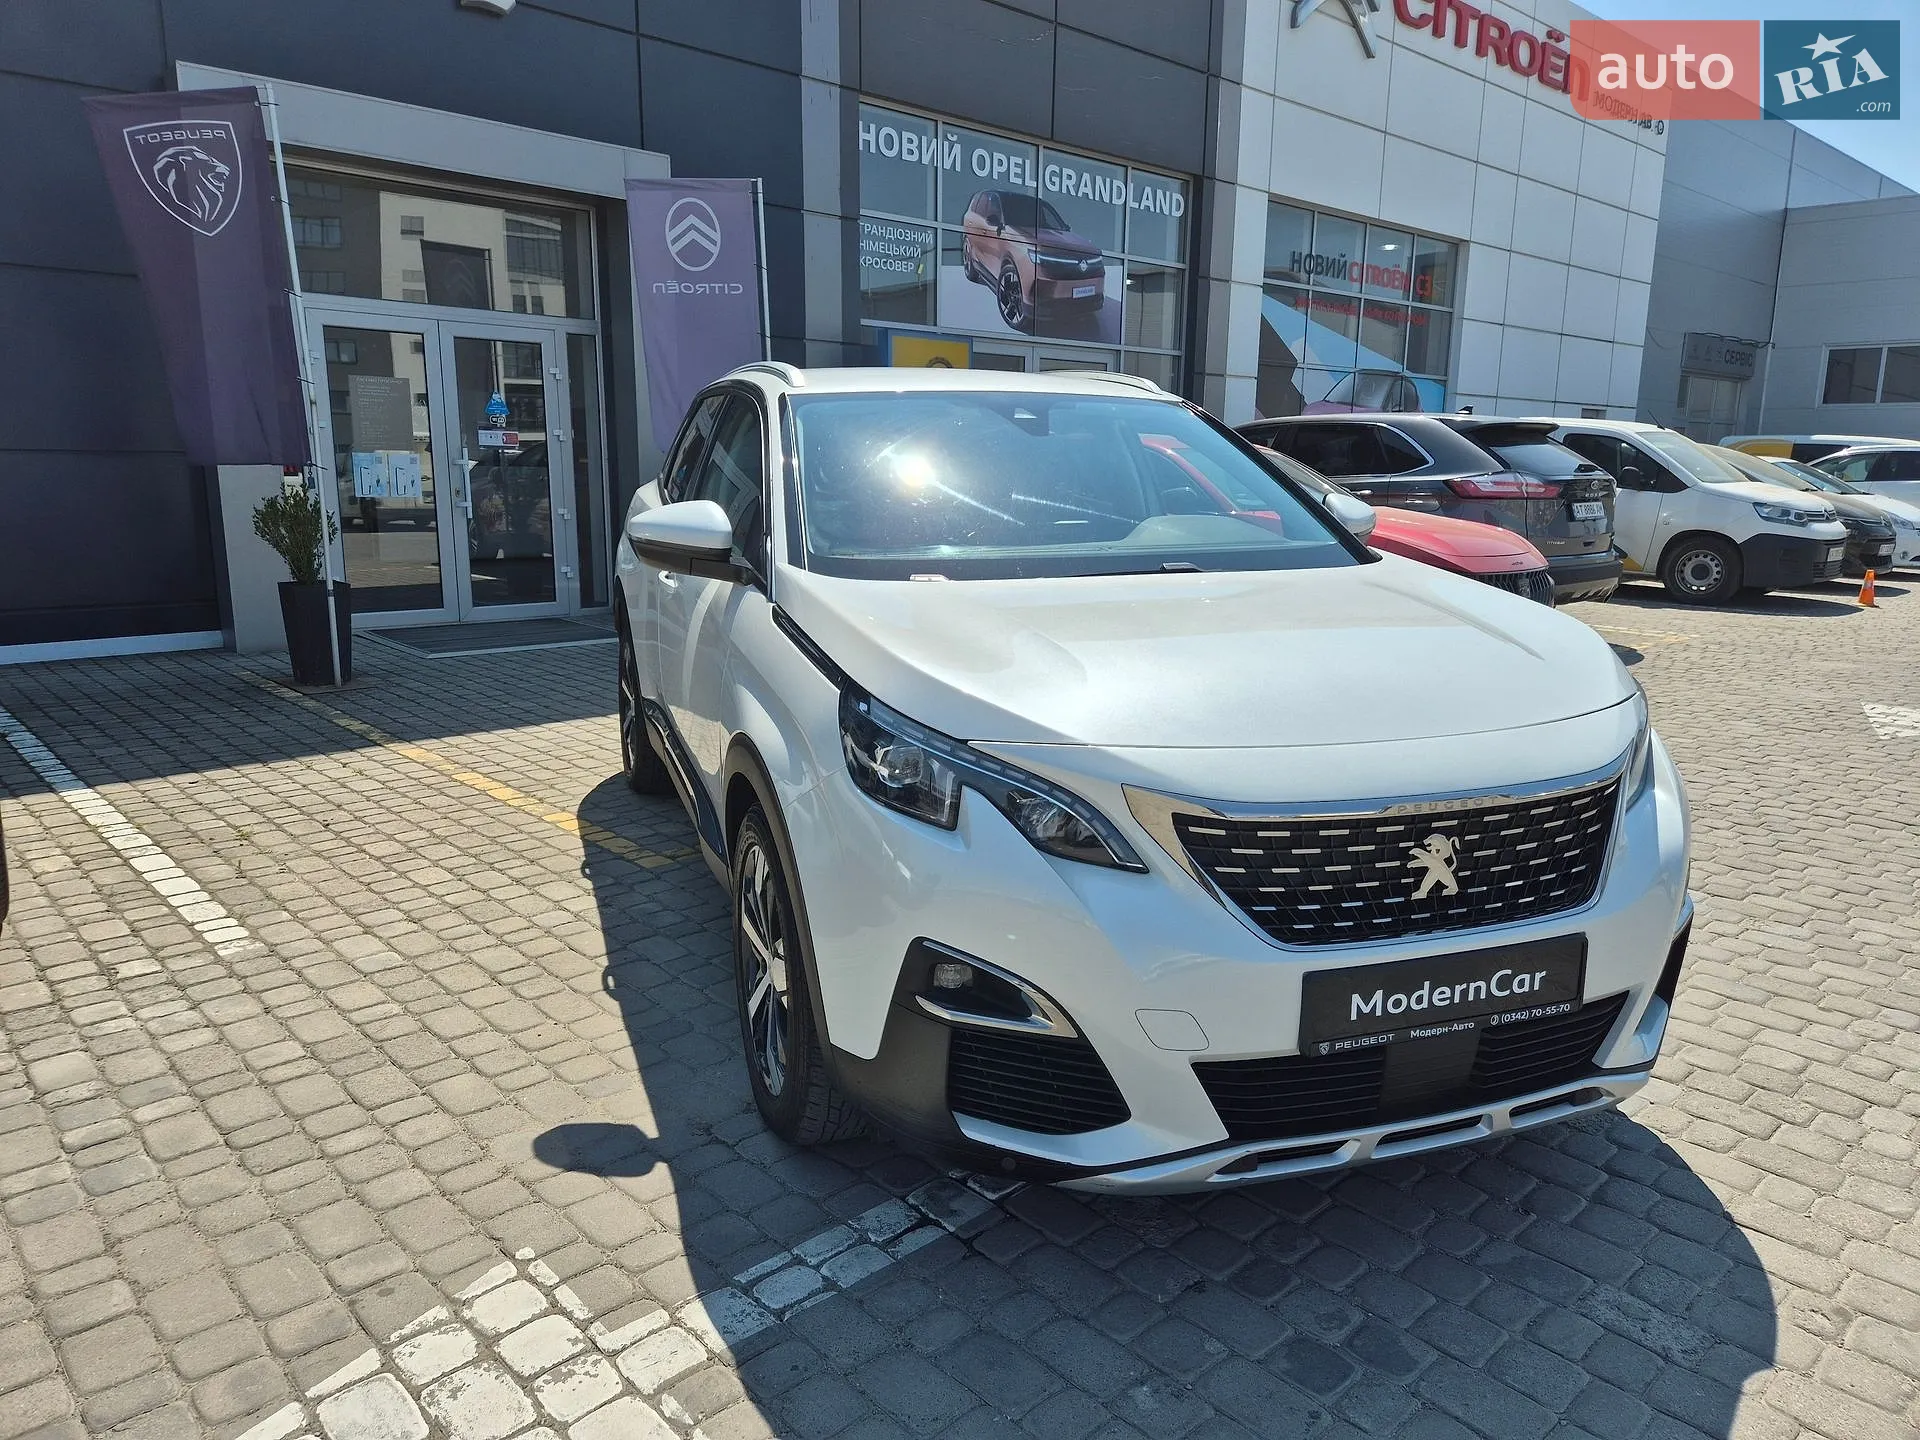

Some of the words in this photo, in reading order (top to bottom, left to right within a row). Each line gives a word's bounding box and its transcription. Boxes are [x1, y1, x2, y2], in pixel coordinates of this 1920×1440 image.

[858, 121, 962, 173] НОВИЙ
[971, 148, 1037, 188] OPEL
[1044, 164, 1185, 218] GRANDLAND
[859, 239, 922, 258] НІМЕЦЬКИЙ
[859, 256, 915, 273] КРОСОВЕР
[1289, 250, 1348, 281] НОВИЙ
[1397, 795, 1496, 815] PEUGEOT
[1350, 969, 1547, 1021] ModernCar
[1501, 1010, 1530, 1024] (0342)
[1531, 1003, 1571, 1017] 70-55-70
[1410, 1021, 1475, 1040] Модерн-Авто
[1335, 1033, 1396, 1051] PEUGEOT
